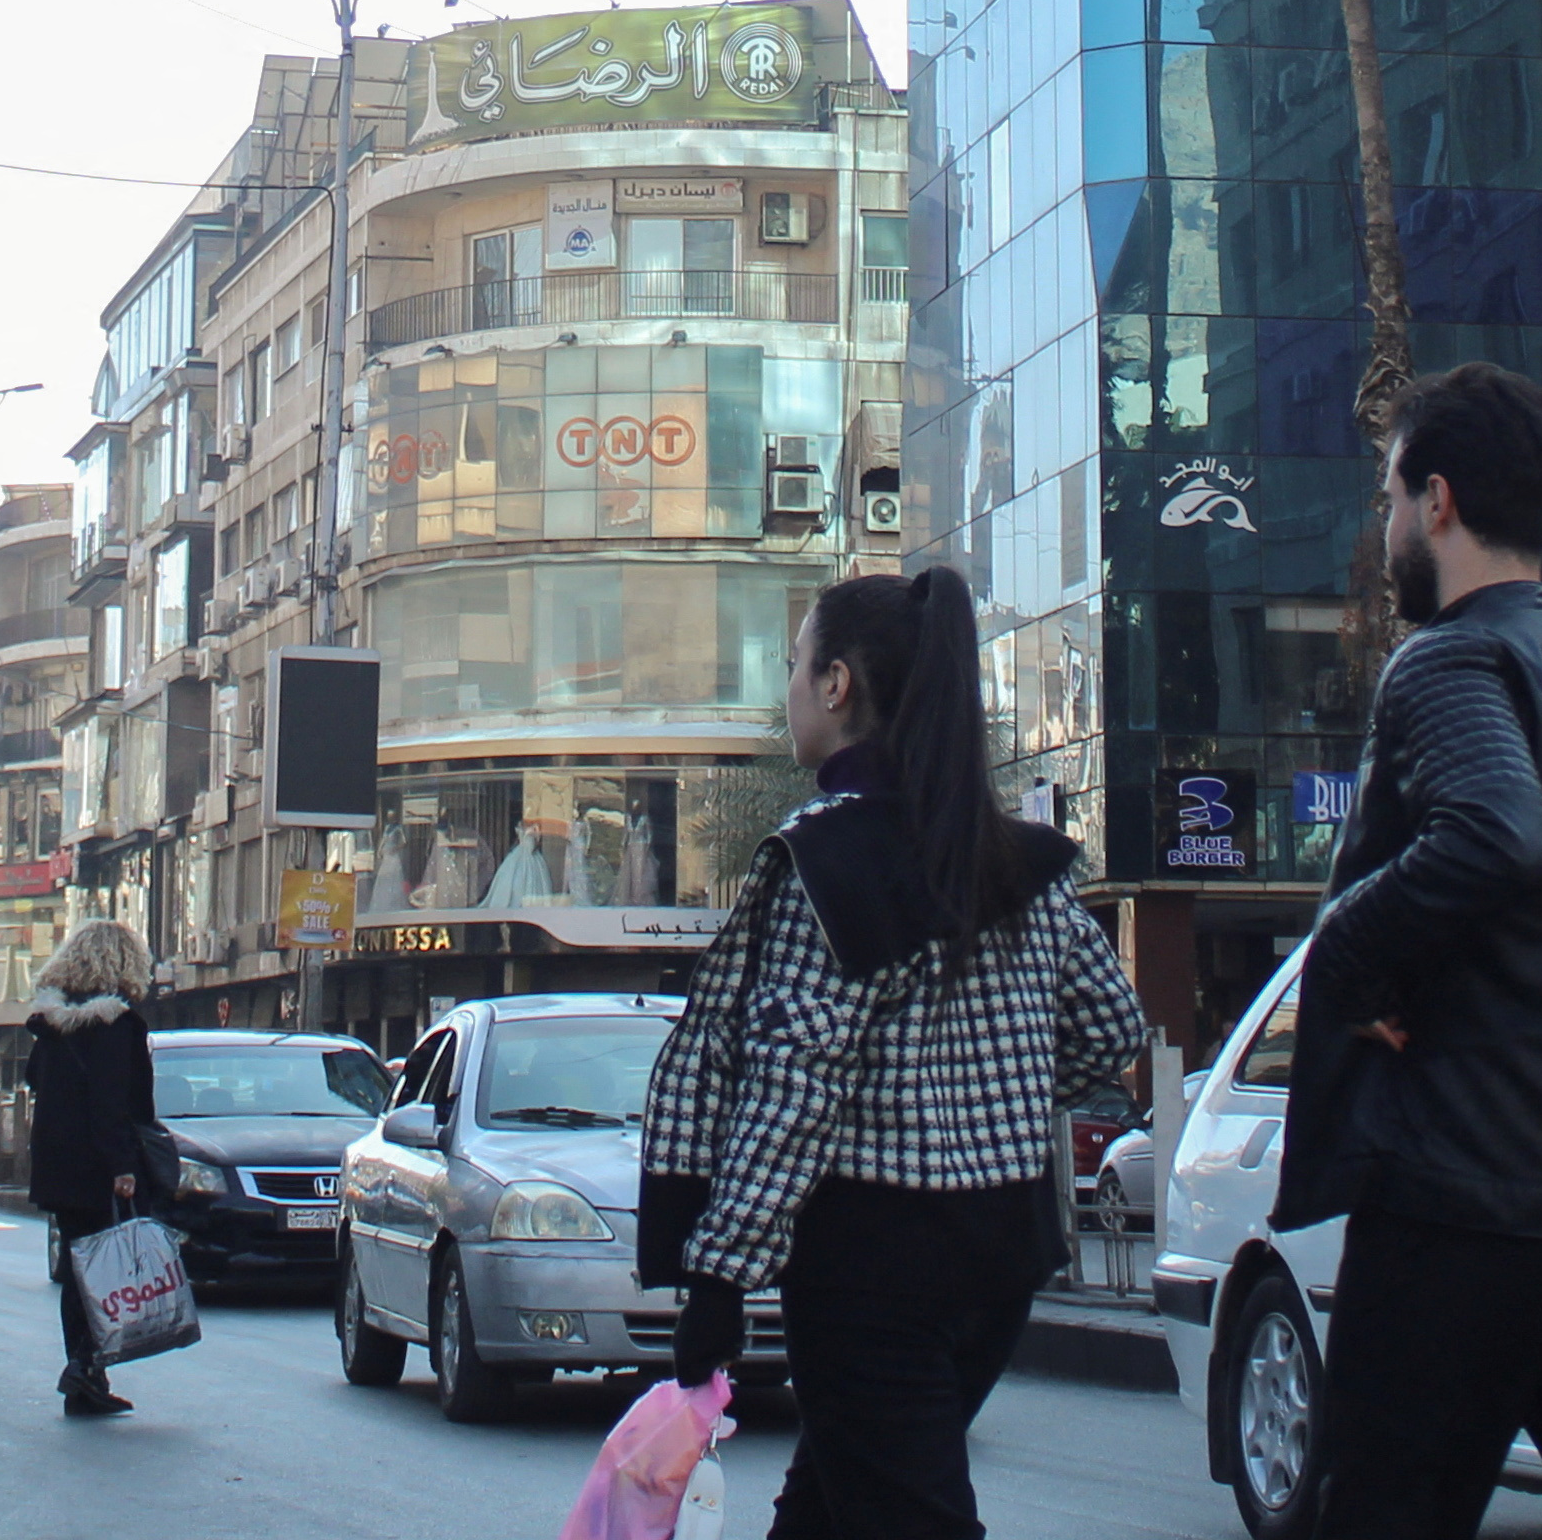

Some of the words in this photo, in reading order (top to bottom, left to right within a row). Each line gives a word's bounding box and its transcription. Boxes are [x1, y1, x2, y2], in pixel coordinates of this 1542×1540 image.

[1159, 456, 1216, 488] المجد
[1308, 774, 1352, 821] BLU
[1180, 836, 1232, 851] BLUE
[1168, 850, 1245, 866] BURGER
[302, 900, 332, 914] 50%
[302, 915, 331, 929] SALE
[622, 913, 722, 940] نتيسا
[355, 927, 451, 952] ONTESSA
